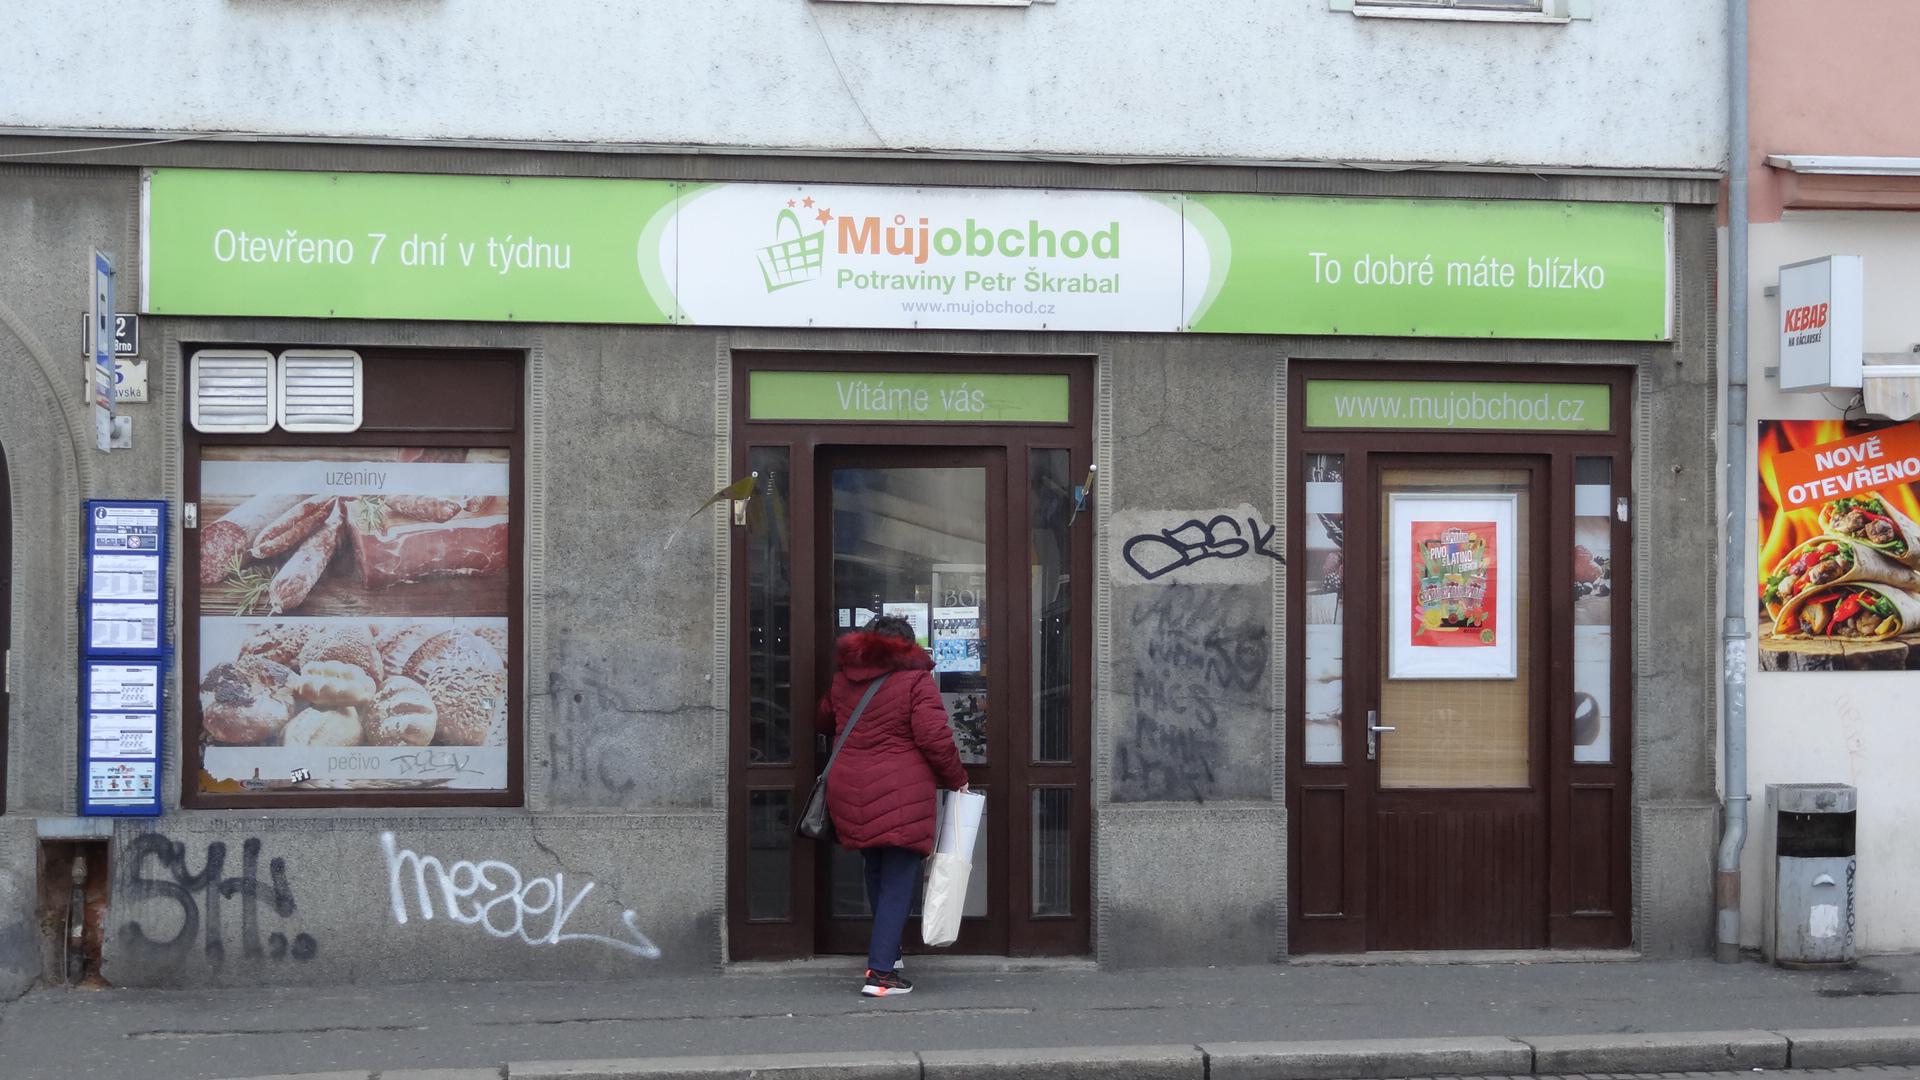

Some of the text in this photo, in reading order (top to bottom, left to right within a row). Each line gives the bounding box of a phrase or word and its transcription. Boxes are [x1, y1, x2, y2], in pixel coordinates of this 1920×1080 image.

[214, 228, 571, 275] Otevřeno 7 dní v týdnu
[836, 266, 1120, 296] Potraviny Petr Škrabal
[1308, 252, 1605, 290] To dobré máte blízko
[901, 299, 1056, 316] www.mujobchod.cz
[1784, 303, 1828, 333] KEBAB
[836, 380, 985, 413] Vítáme vás
[1335, 391, 1585, 426] www.mujobchod.cz
[1814, 435, 1884, 472] NOVĚ
[326, 468, 387, 489] uzeniny
[1787, 457, 1920, 504] OTEVŘENO
[1430, 546, 1447, 560] PIVO
[328, 752, 381, 773] pečivo
